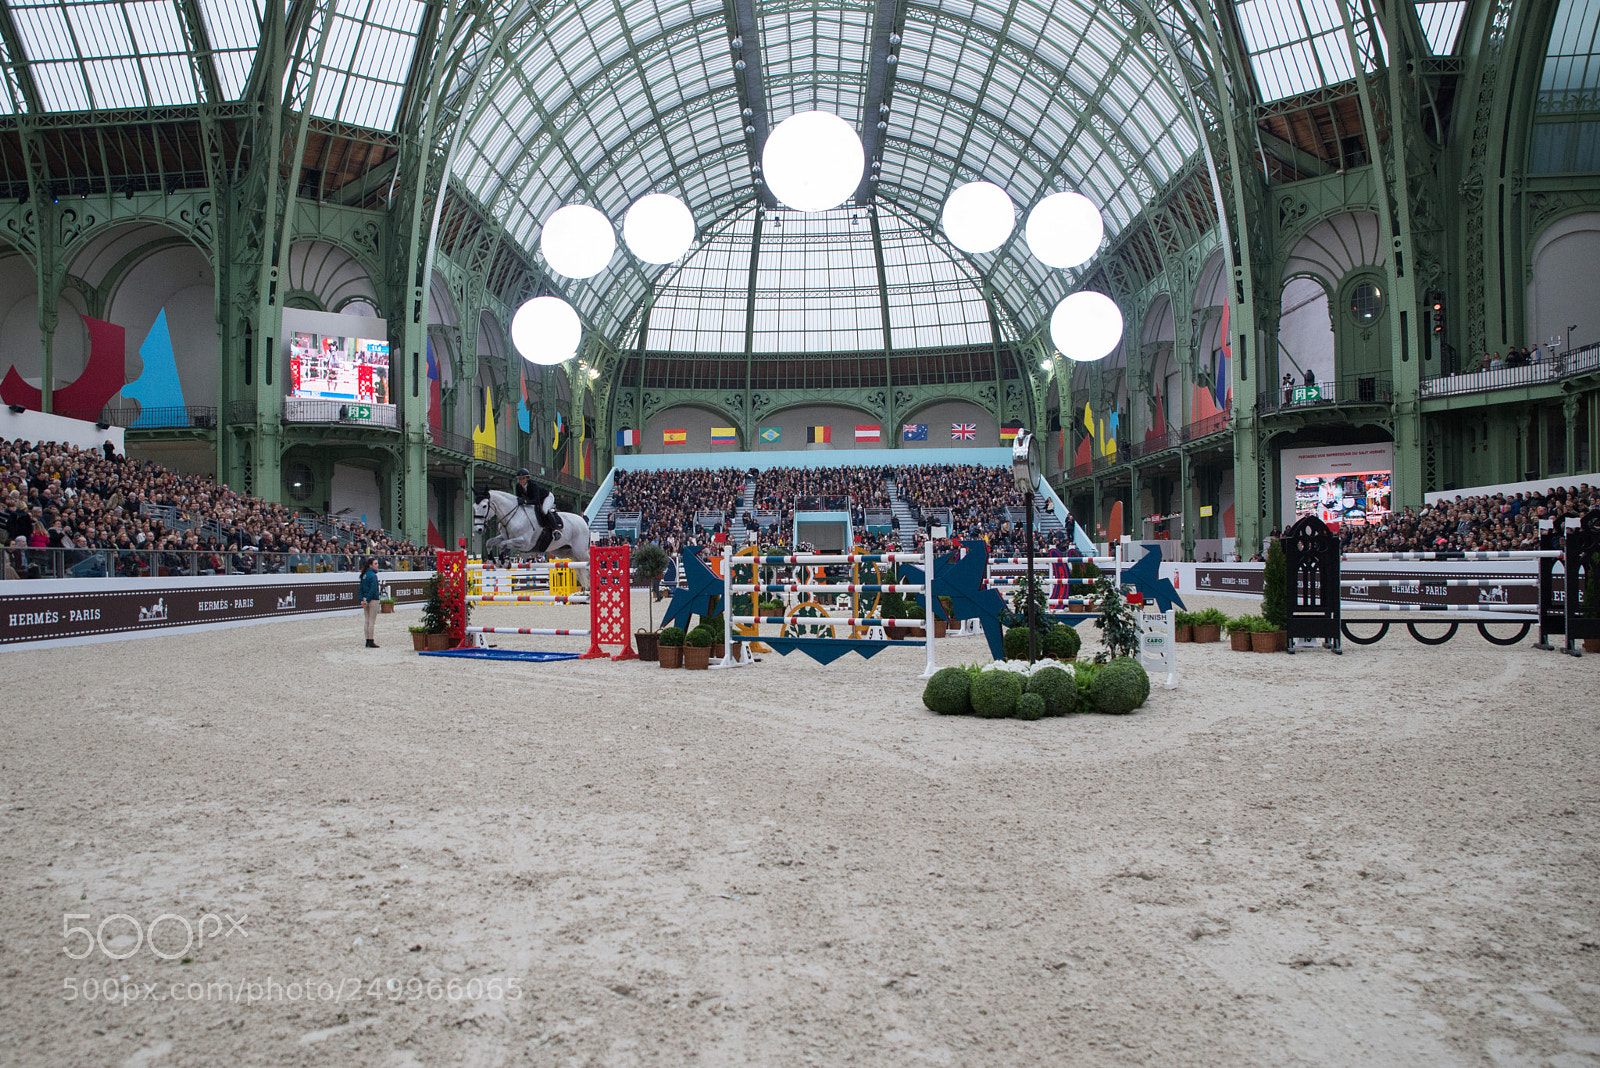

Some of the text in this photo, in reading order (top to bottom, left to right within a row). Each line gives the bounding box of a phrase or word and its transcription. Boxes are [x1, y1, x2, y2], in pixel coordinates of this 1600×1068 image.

[1425, 586, 1448, 595] PARIS
[316, 592, 335, 602] HERMÈS
[198, 598, 228, 611] HERMÈS
[234, 598, 254, 608] PARIS
[9, 610, 59, 626] HERMÈS
[70, 609, 101, 621] PARIS
